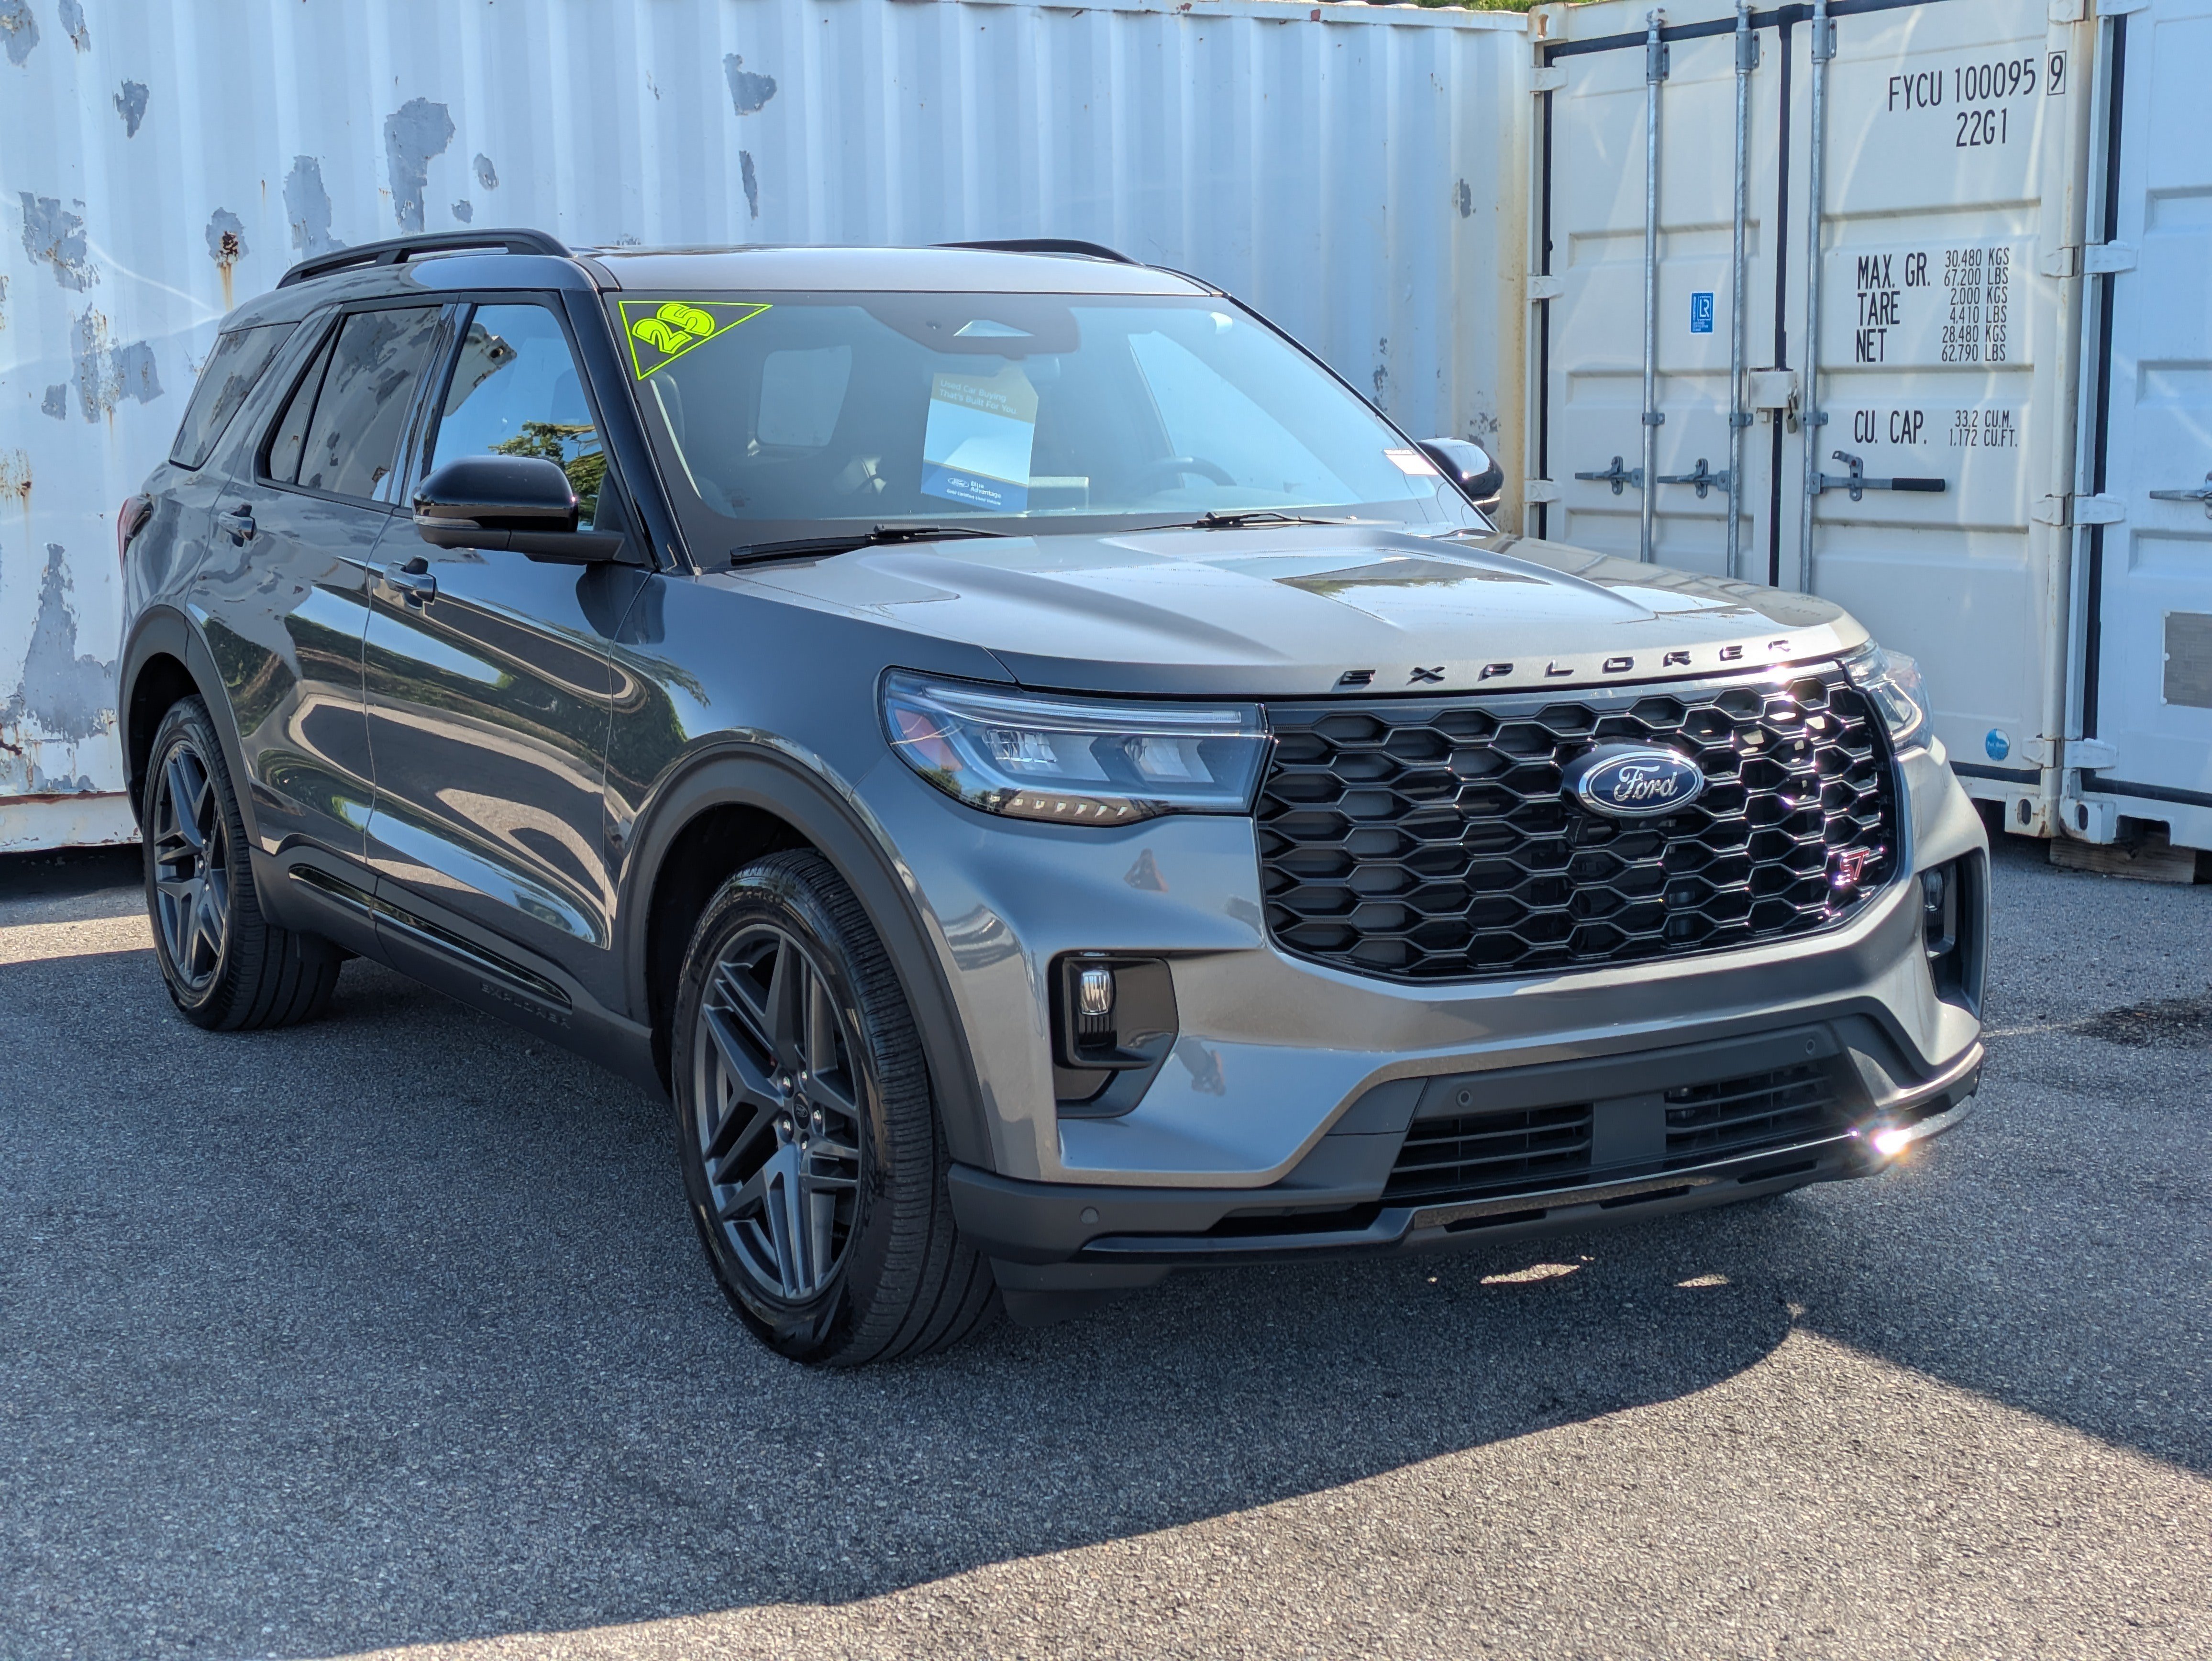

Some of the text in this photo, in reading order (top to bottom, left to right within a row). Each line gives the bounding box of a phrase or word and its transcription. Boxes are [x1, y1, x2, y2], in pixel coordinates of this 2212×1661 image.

[1889, 54, 2064, 112] FYCU 100095 9
[1956, 108, 2007, 147] 22G1
[1988, 247, 2010, 266] KGS
[1857, 252, 1931, 290] MAX. GR.
[1988, 266, 2009, 285] LBS
[1987, 286, 2008, 304] KGS
[1857, 290, 1901, 326] TARE
[1986, 305, 2007, 323] LBS
[632, 303, 715, 354] 25
[1985, 324, 2006, 343] KGS
[1856, 328, 1887, 363] NET
[1985, 343, 2006, 362] LBS
[940, 378, 1006, 403] Used Car Buying
[940, 388, 963, 401] That's
[965, 395, 984, 407] Built
[986, 400, 999, 410] For
[1854, 410, 1927, 444] CU. CAP.
[1955, 410, 2012, 428] 33.2 CU.M.
[1984, 428, 2018, 447] CU.FT.
[970, 486, 1002, 498] Advantage
[1338, 640, 1792, 686] EXPLORER
[1614, 765, 1678, 801] Ford
[1836, 847, 1871, 886] ST
